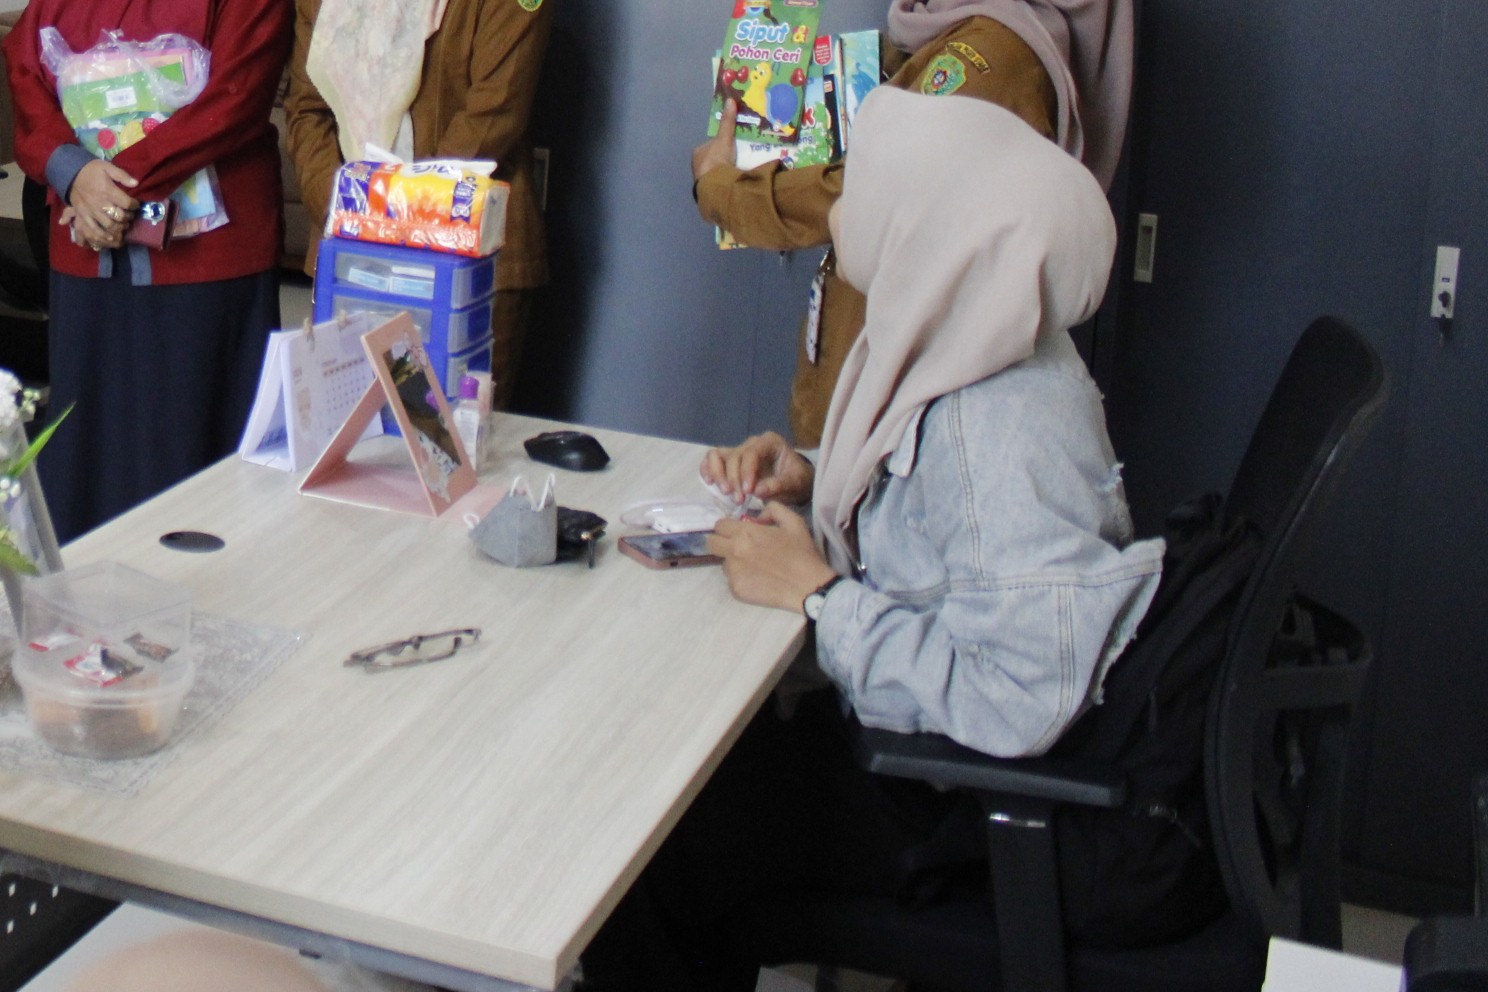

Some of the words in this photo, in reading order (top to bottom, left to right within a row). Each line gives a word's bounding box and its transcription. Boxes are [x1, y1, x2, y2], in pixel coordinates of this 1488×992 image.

[735, 19, 789, 45] Siput
[792, 25, 809, 43] &
[730, 44, 769, 60] Pohon
[772, 48, 801, 63] Ceri
